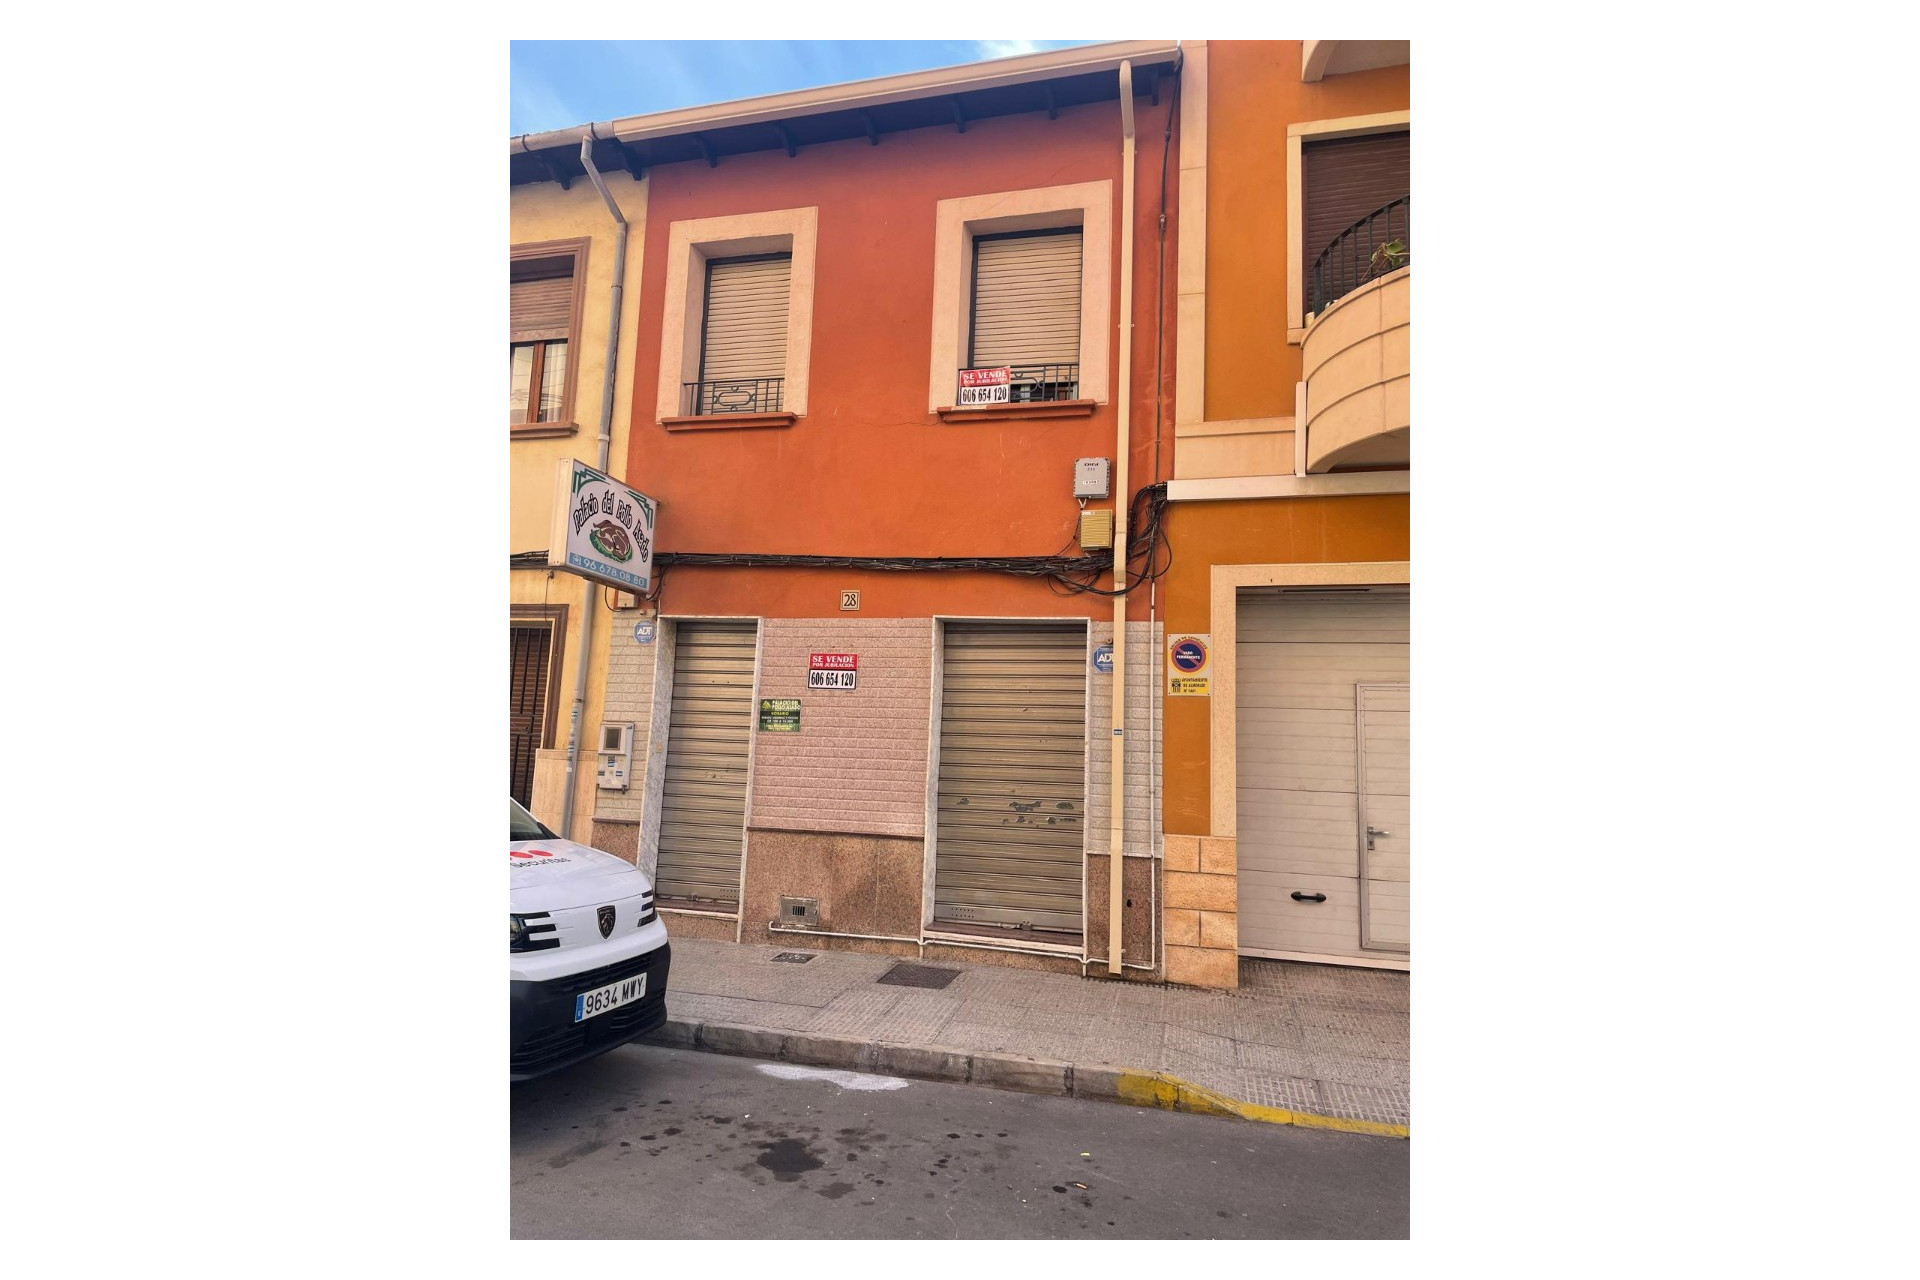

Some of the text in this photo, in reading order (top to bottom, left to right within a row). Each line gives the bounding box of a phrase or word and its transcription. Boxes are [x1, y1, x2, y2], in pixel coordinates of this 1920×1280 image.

[963, 370, 1007, 380] SE VENDE
[962, 387, 1007, 402] 606 654 120
[573, 489, 650, 562] Palacio del Pollo Asado
[583, 559, 645, 587] 96 678 08 80
[844, 593, 857, 607] 28
[637, 626, 653, 635] ADT
[812, 655, 855, 663] SE VENDE
[811, 671, 854, 687] 606 654 120
[585, 977, 645, 1015] 9634 MWY
